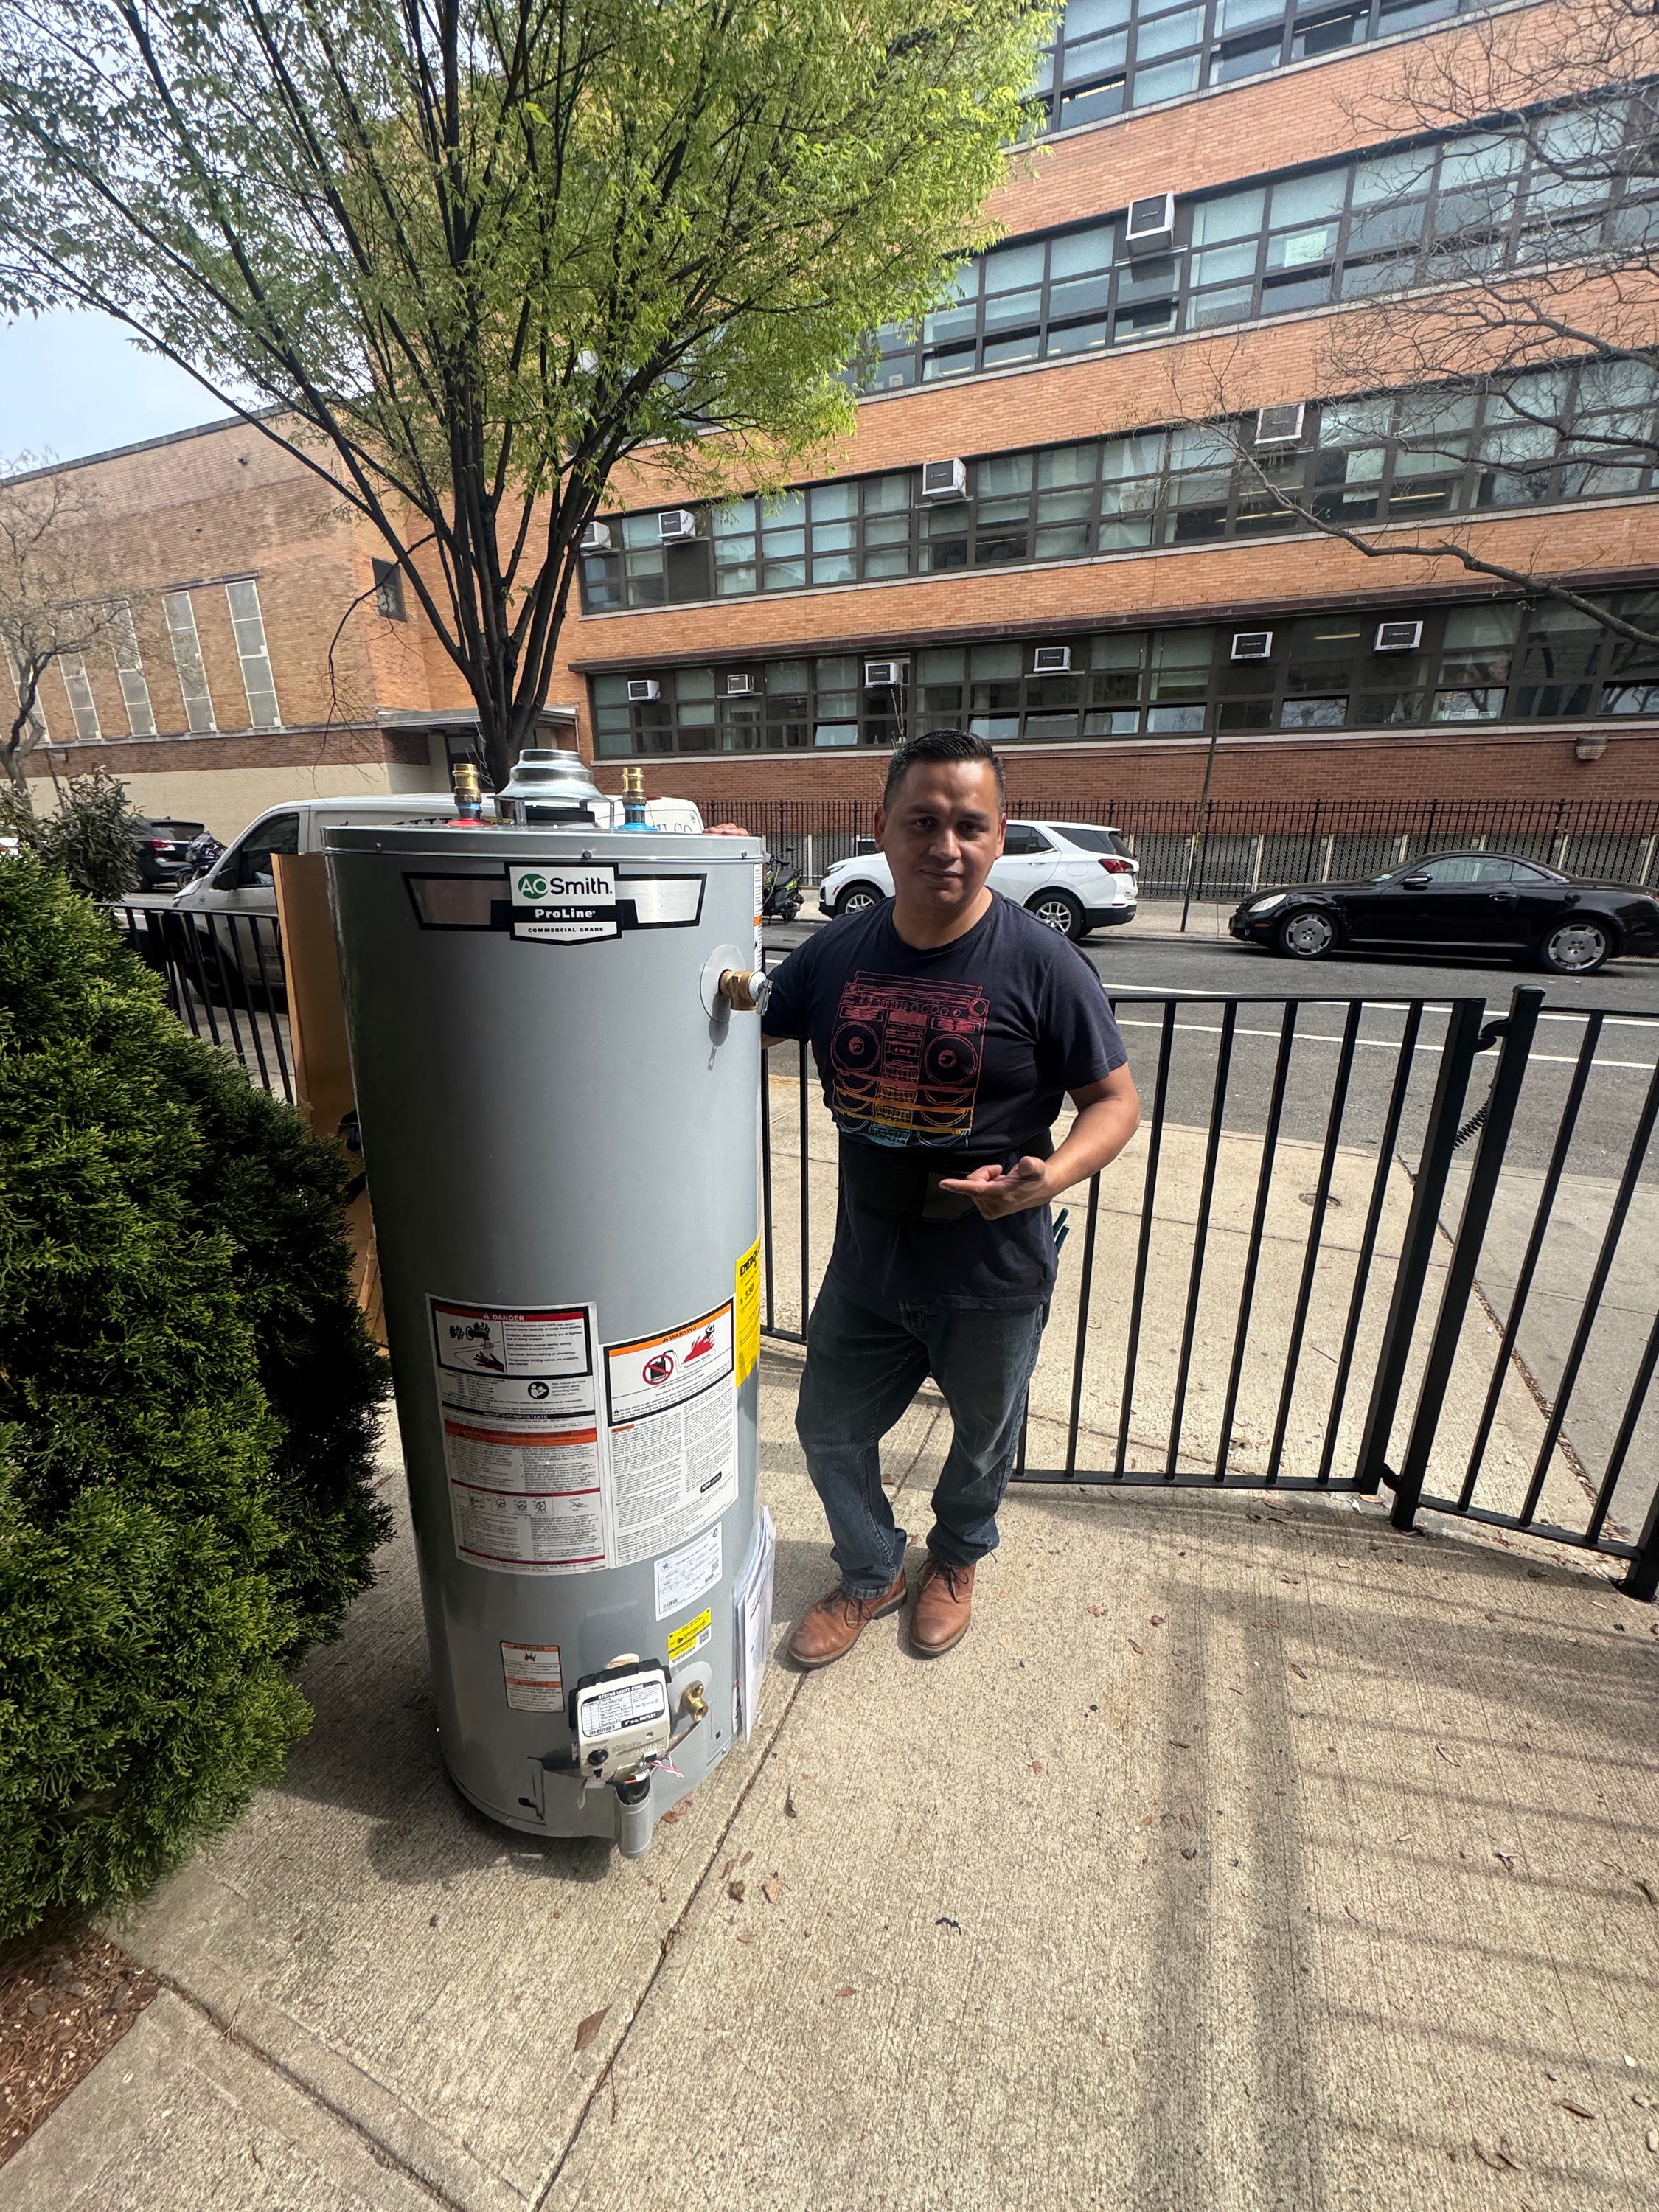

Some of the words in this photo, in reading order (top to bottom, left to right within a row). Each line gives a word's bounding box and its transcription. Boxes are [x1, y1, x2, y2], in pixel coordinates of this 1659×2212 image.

[520, 877, 549, 894] AO
[669, 1325, 697, 1340] WARNING
[598, 1691, 616, 1700] STATUS
[639, 1713, 657, 1722] OUTLET
